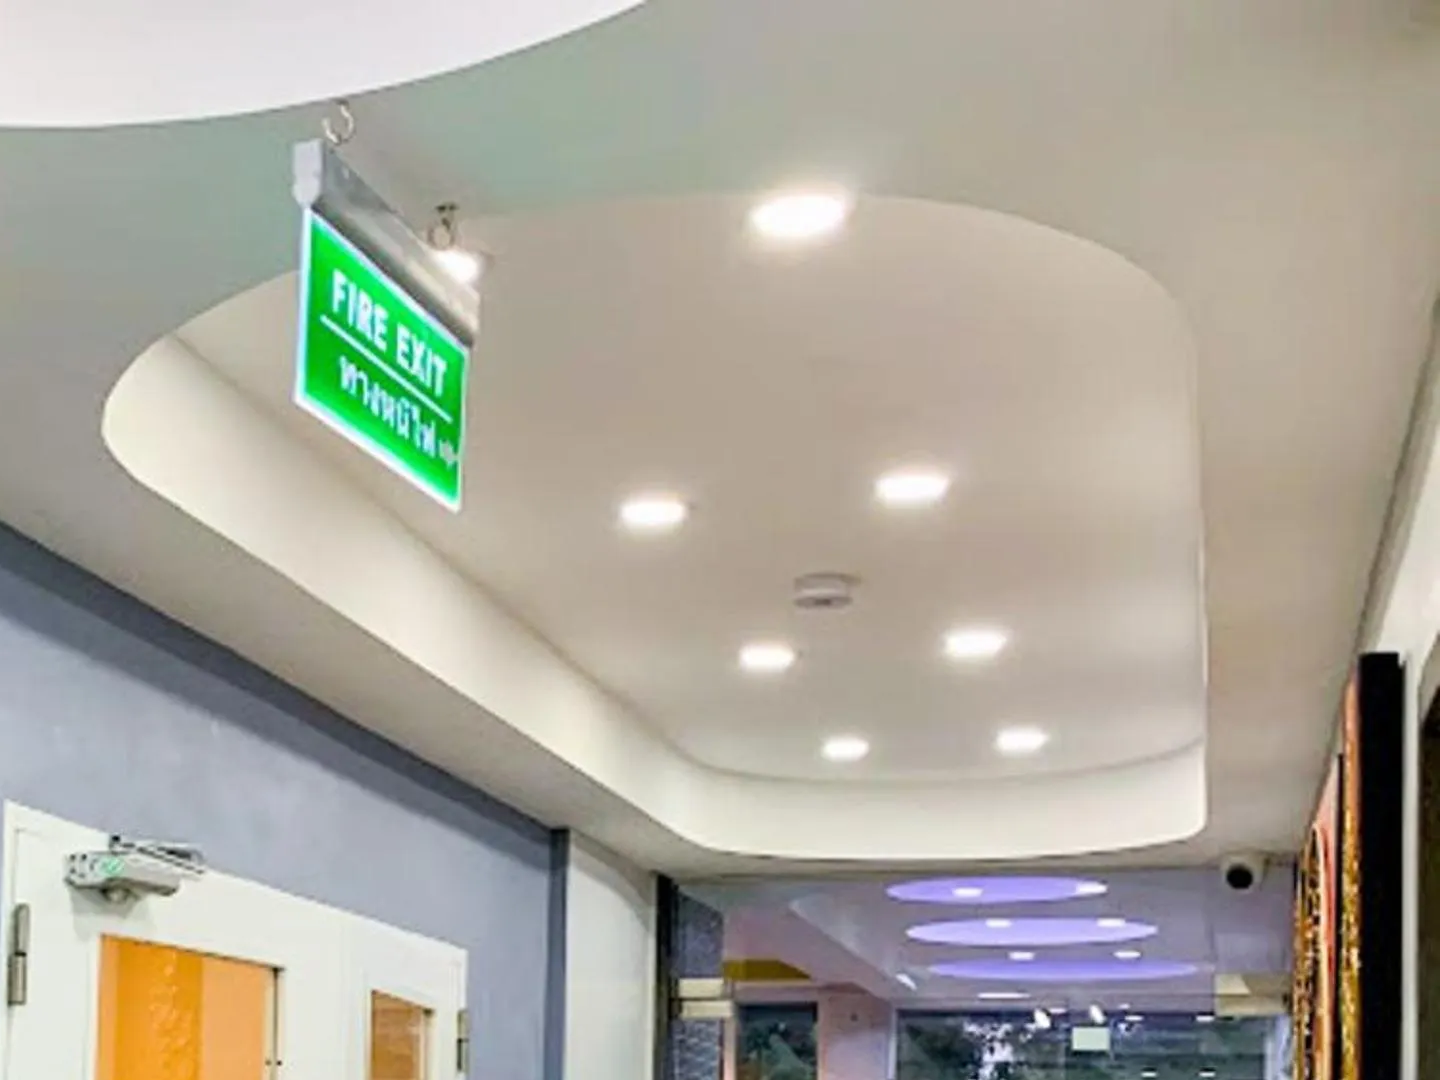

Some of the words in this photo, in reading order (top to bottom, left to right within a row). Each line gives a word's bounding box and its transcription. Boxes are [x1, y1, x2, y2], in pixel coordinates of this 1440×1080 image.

[331, 268, 389, 352] FIRE
[395, 320, 448, 398] EXIT
[338, 354, 437, 459] ทางหนีไฟ
